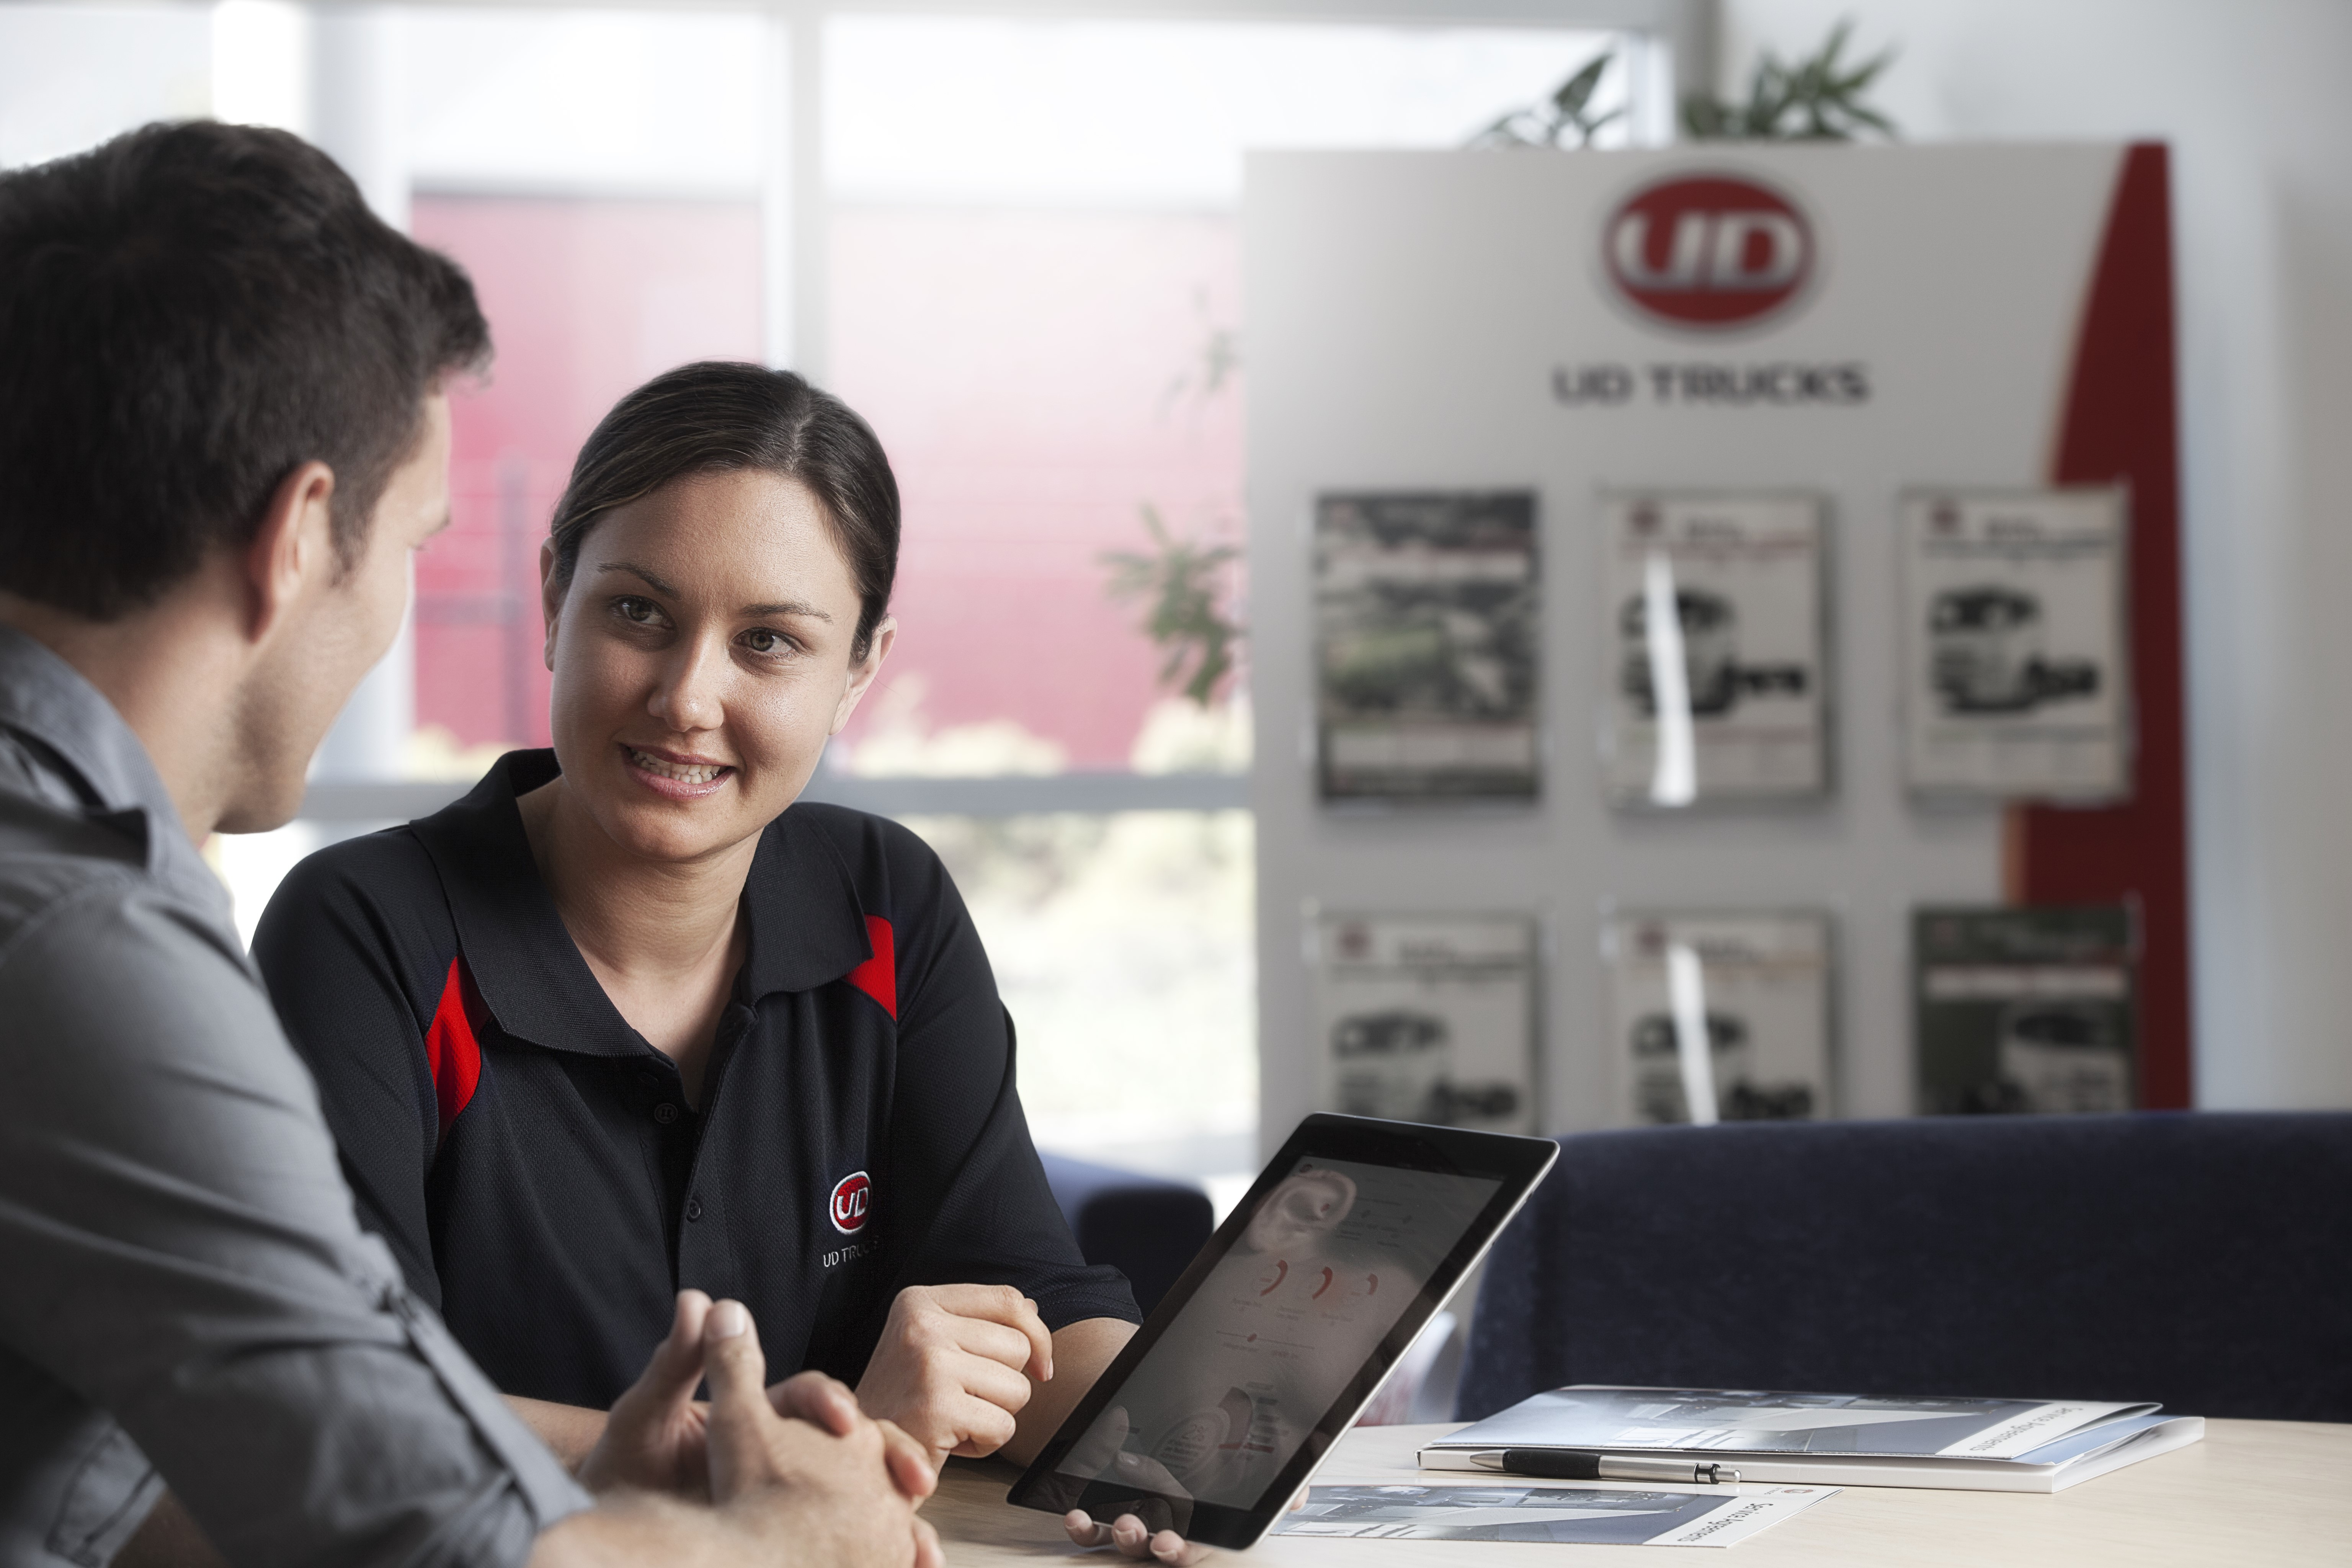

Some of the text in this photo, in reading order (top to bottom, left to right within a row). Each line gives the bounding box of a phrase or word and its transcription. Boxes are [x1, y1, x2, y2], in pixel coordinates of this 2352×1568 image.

[1612, 209, 1805, 291] UD
[1551, 361, 1870, 407] UD TRUCKS
[837, 1187, 868, 1220] UD
[823, 1251, 839, 1267] UD
[1969, 1422, 2045, 1451] Agreements
[1727, 1503, 1774, 1518] Service
